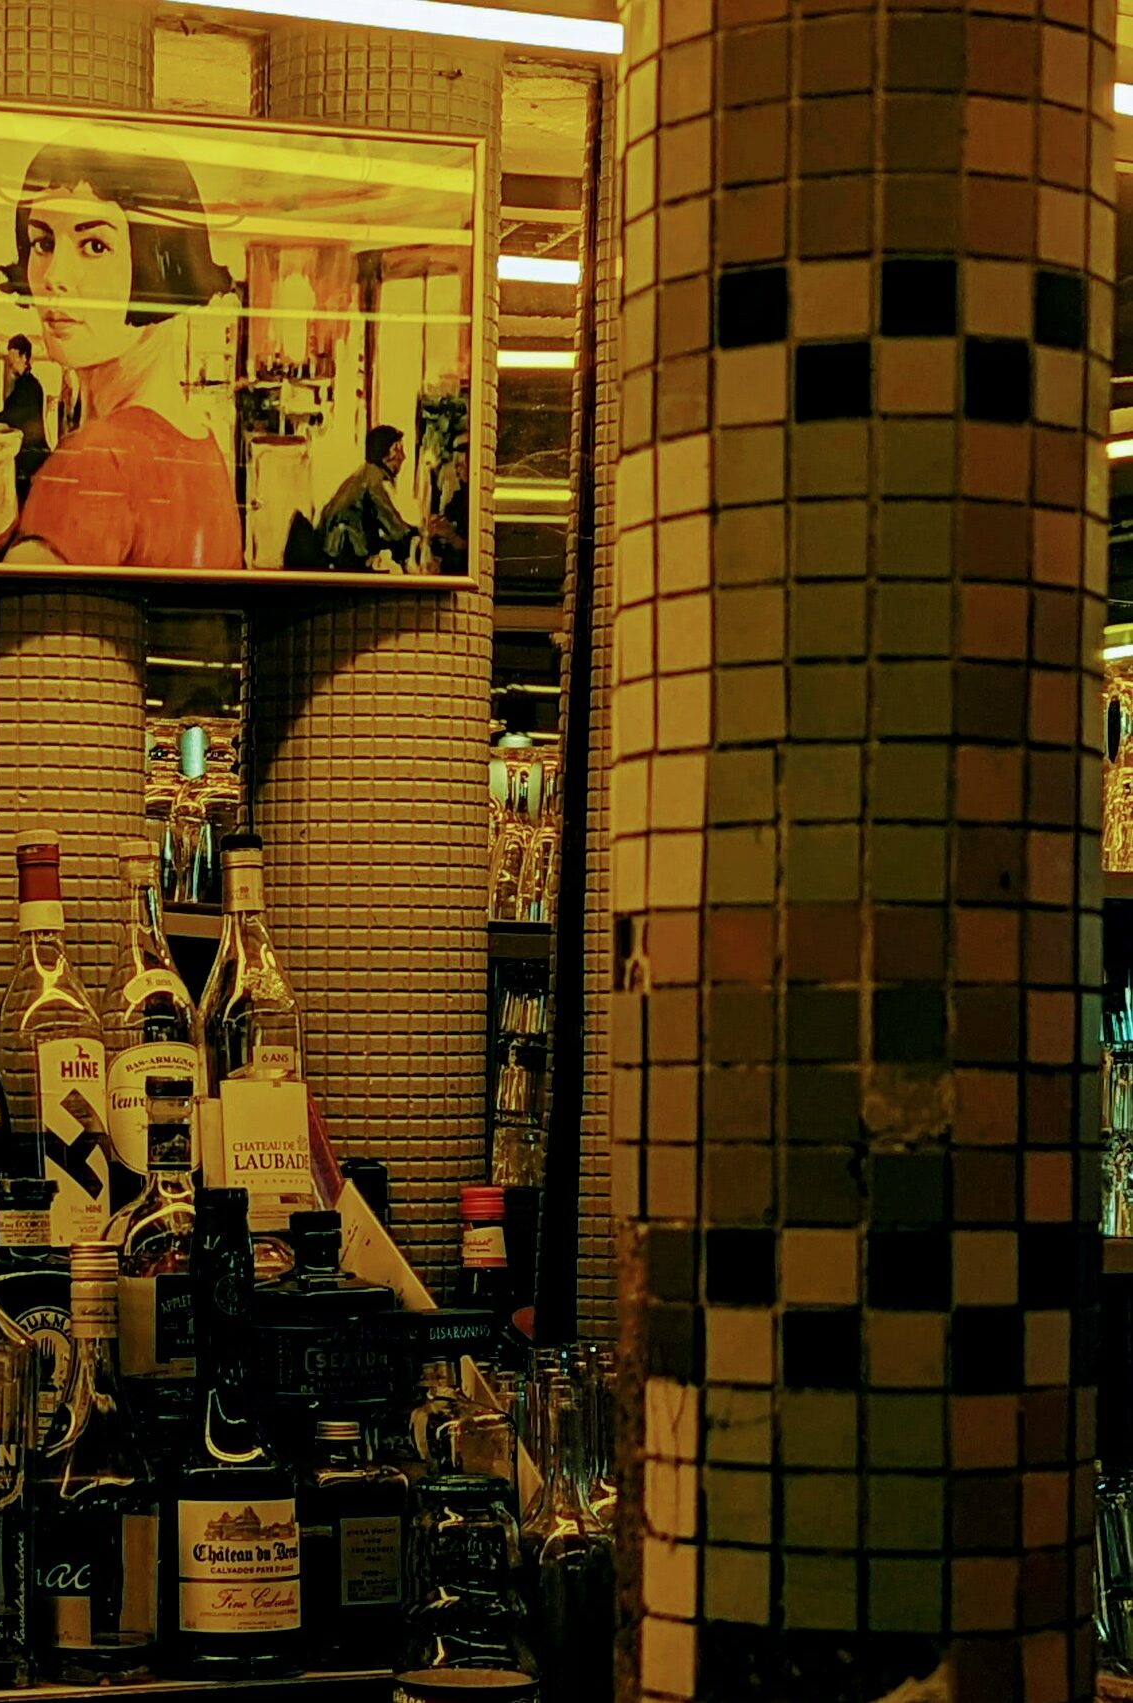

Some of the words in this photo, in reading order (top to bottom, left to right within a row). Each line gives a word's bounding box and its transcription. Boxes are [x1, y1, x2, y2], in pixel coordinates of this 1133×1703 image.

[270, 1053, 289, 1063] ANS
[60, 1060, 99, 1079] HINE
[232, 1141, 281, 1151] CHATEAU
[234, 1153, 309, 1170] LAUBADE
[192, 1541, 253, 1565] Château
[255, 1546, 272, 1561] du
[210, 1567, 254, 1575] CALVADOS
[211, 1588, 247, 1609] Fine
